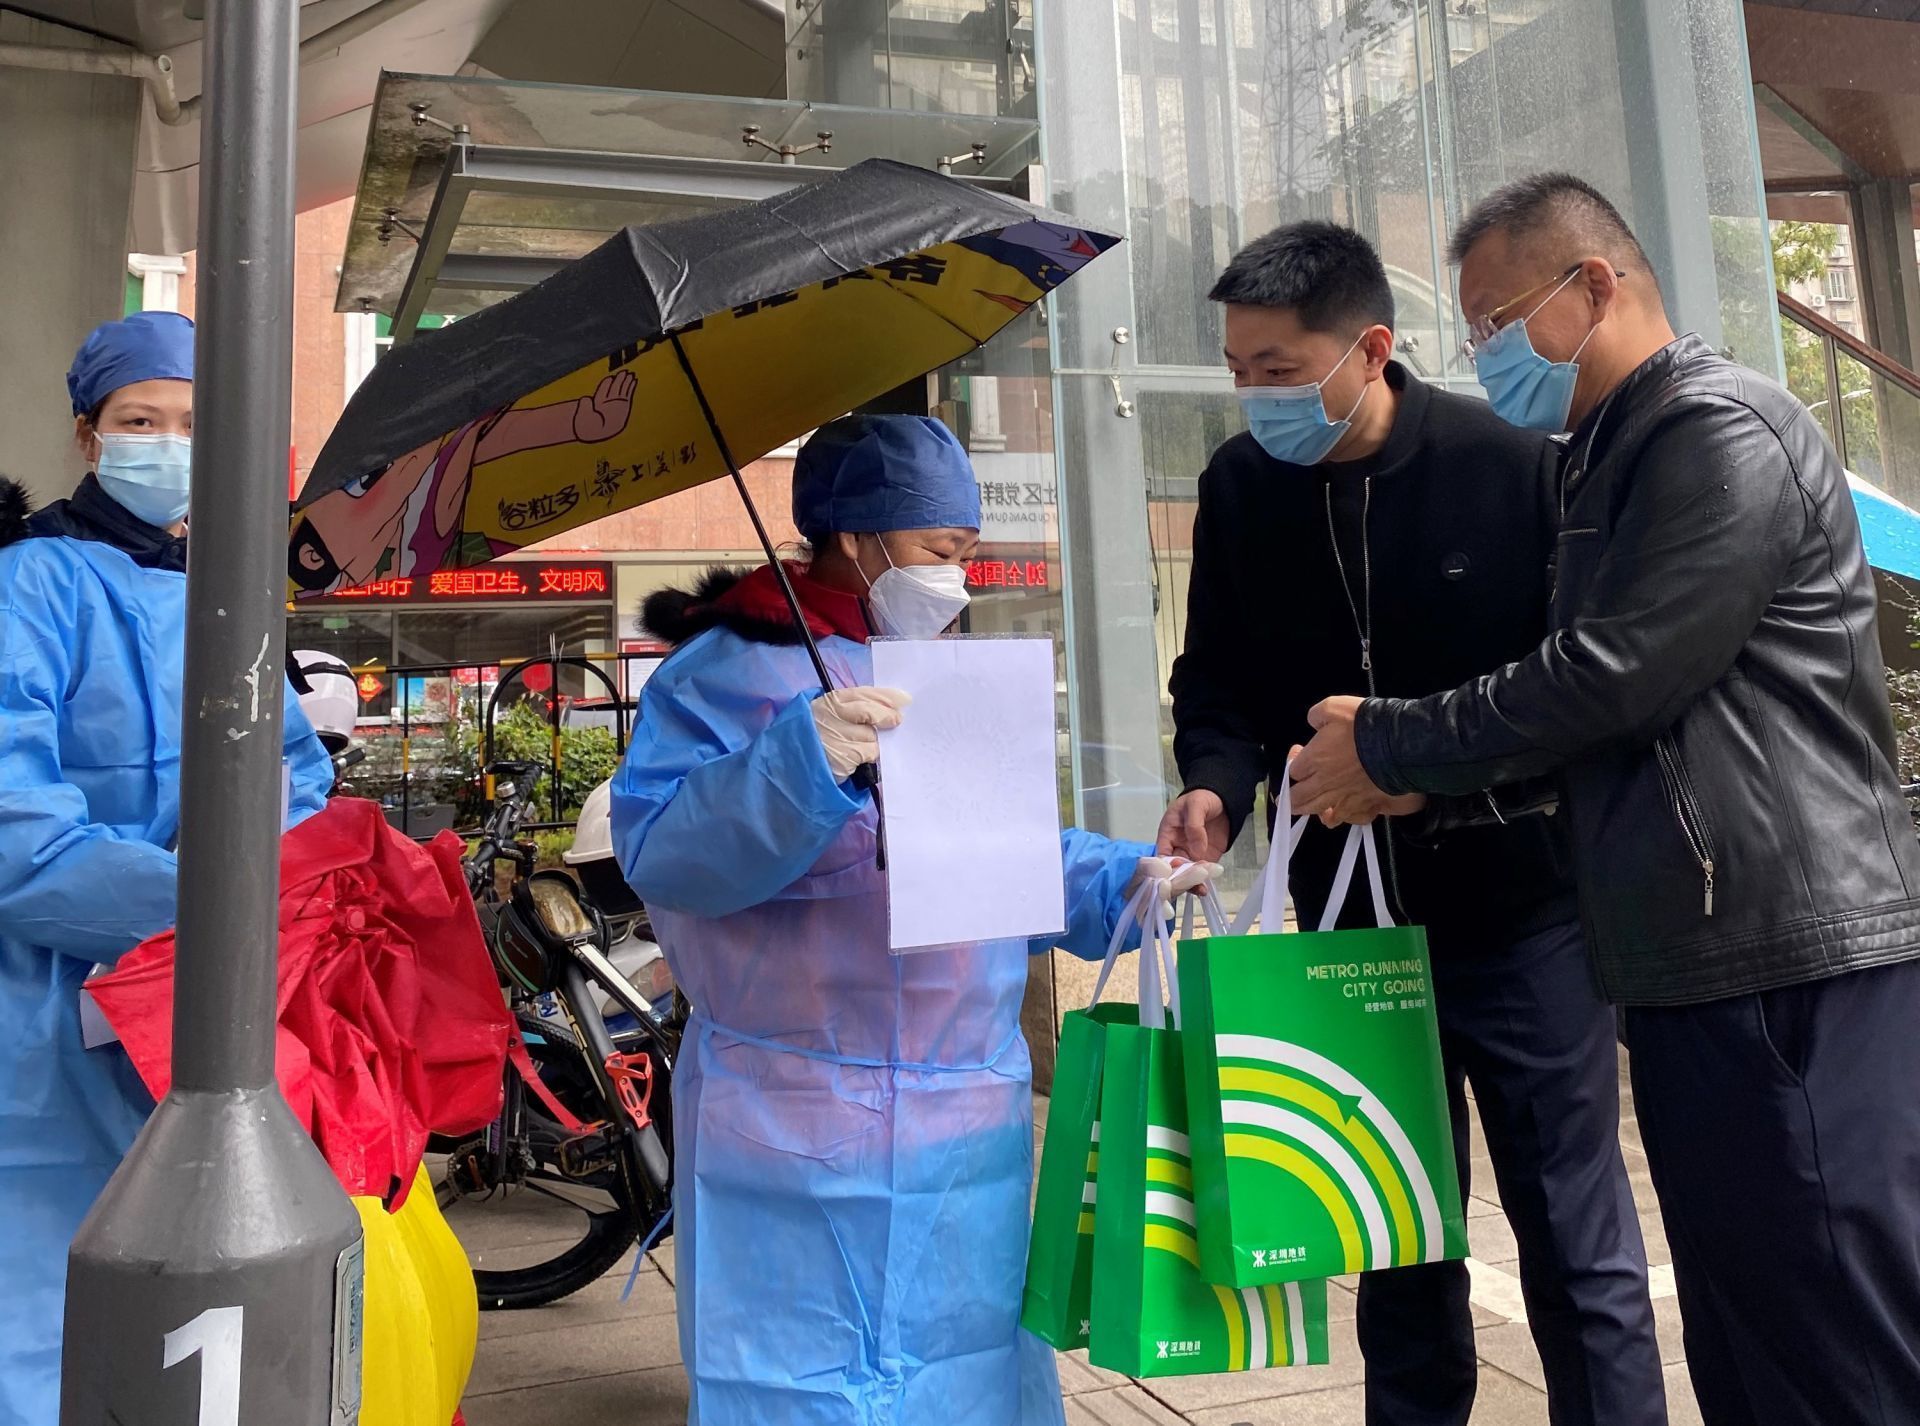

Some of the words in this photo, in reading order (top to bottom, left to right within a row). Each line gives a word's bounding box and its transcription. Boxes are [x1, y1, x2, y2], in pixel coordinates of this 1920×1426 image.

[1306, 963, 1359, 980] METRO
[1363, 959, 1423, 977] RUNNING
[1343, 982, 1378, 998] CITY
[1383, 978, 1425, 995] GOING
[163, 1305, 244, 1426] 1
